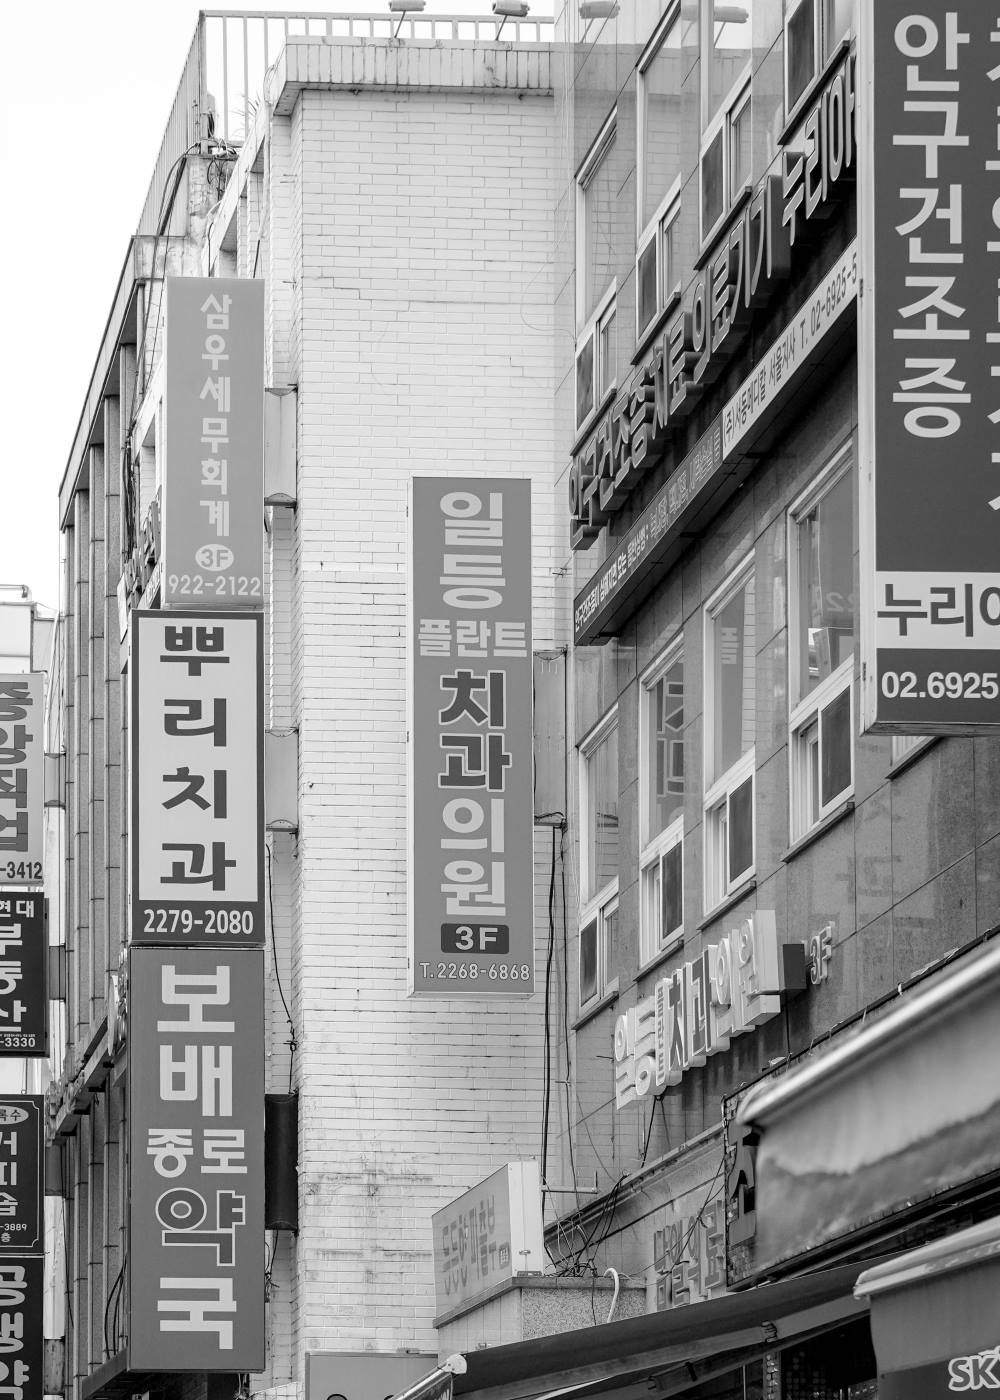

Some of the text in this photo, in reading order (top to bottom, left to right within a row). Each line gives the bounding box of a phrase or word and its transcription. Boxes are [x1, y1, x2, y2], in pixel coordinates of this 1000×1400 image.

[893, 12, 971, 438] 안구건조증
[199, 293, 233, 538] 삼우세무회계
[199, 548, 231, 568] 3F
[438, 490, 503, 610] 일등
[168, 573, 261, 598] 922-2122
[417, 617, 529, 658] 플란트
[880, 670, 999, 701] 02.6925
[159, 625, 237, 893] 뿌리치과
[437, 668, 512, 917] 치과의원
[142, 908, 255, 936] 2279-2080
[454, 926, 498, 952] 3F
[420, 960, 531, 983] T.2268-6868
[157, 964, 236, 1117] 보배
[147, 1128, 249, 1178] 종로
[154, 1187, 246, 1350] 약국
